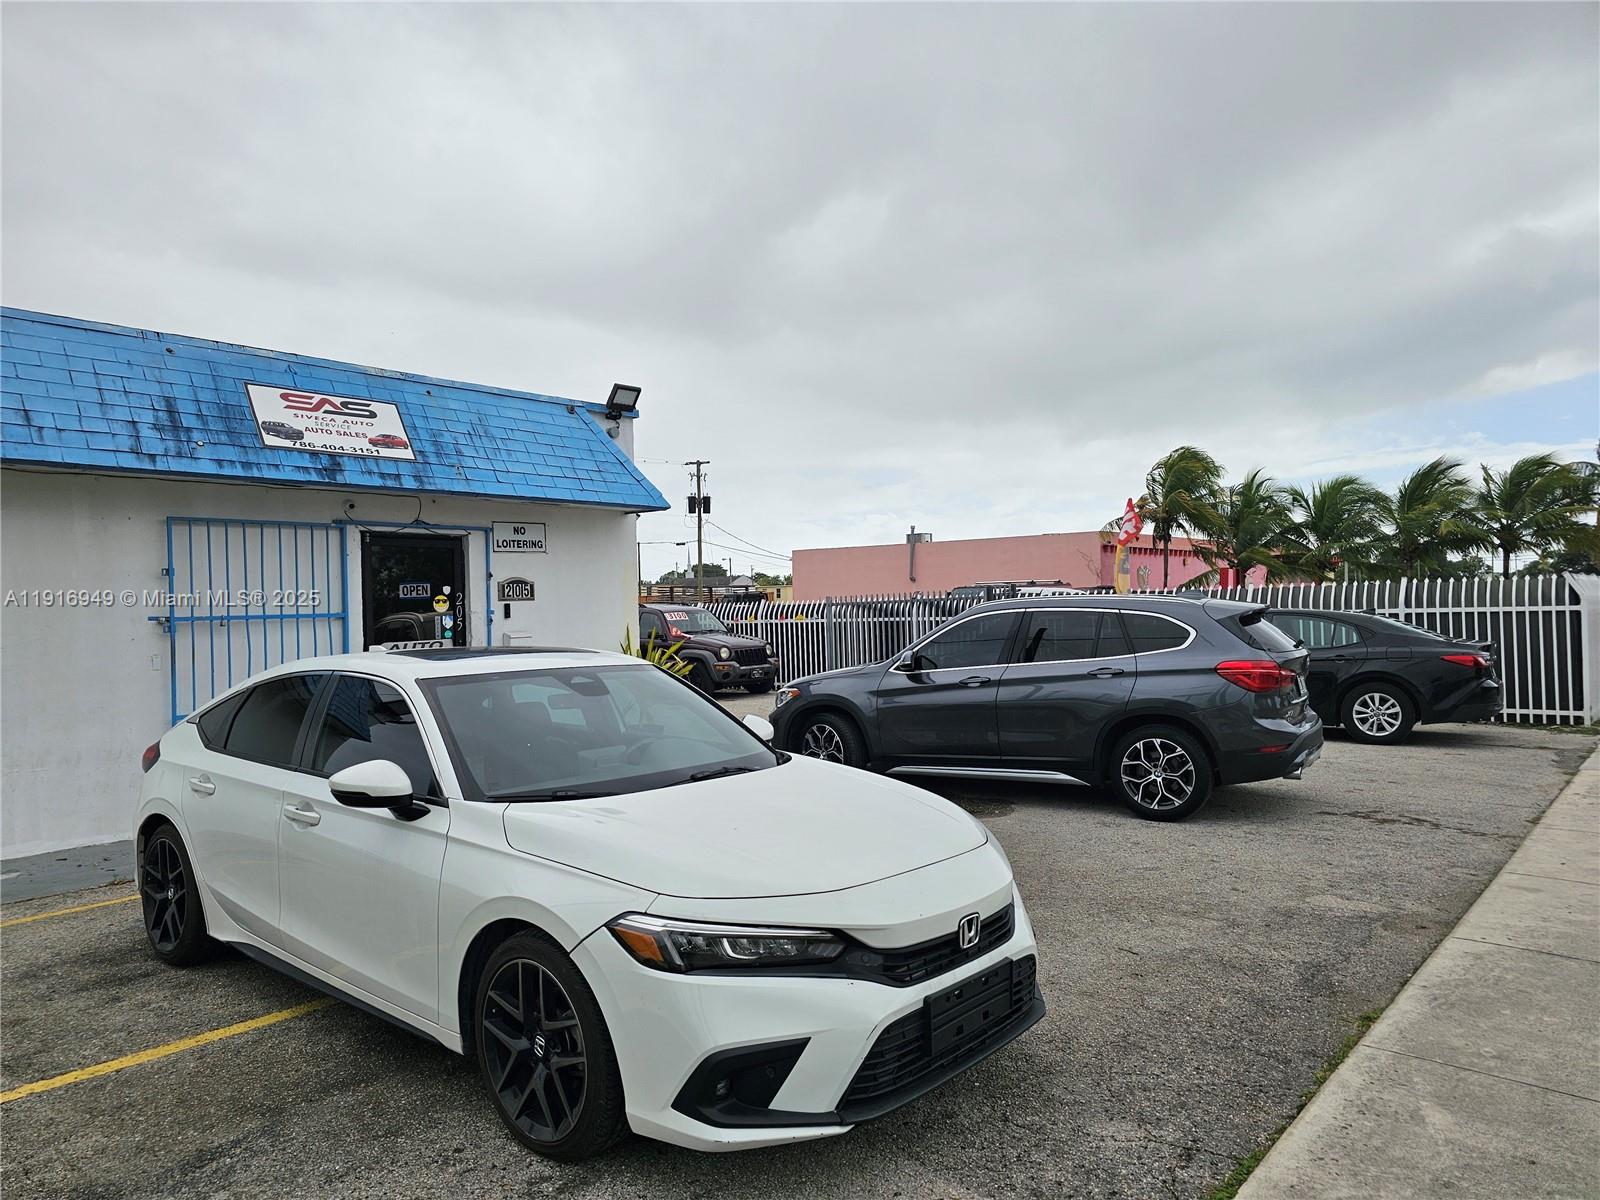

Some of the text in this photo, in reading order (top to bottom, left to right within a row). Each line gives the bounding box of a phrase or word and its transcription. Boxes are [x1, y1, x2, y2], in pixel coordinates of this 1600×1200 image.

[293, 413, 374, 427] SIVECA AUTO
[314, 421, 351, 430] SERVICE
[304, 426, 368, 439] AUTO SALES
[290, 440, 381, 455] 786-404-3151
[513, 526, 526, 536] NO
[496, 539, 543, 549] LOITERING
[402, 584, 428, 597] OPEN
[505, 583, 530, 598] 205
[455, 592, 463, 632] 205
